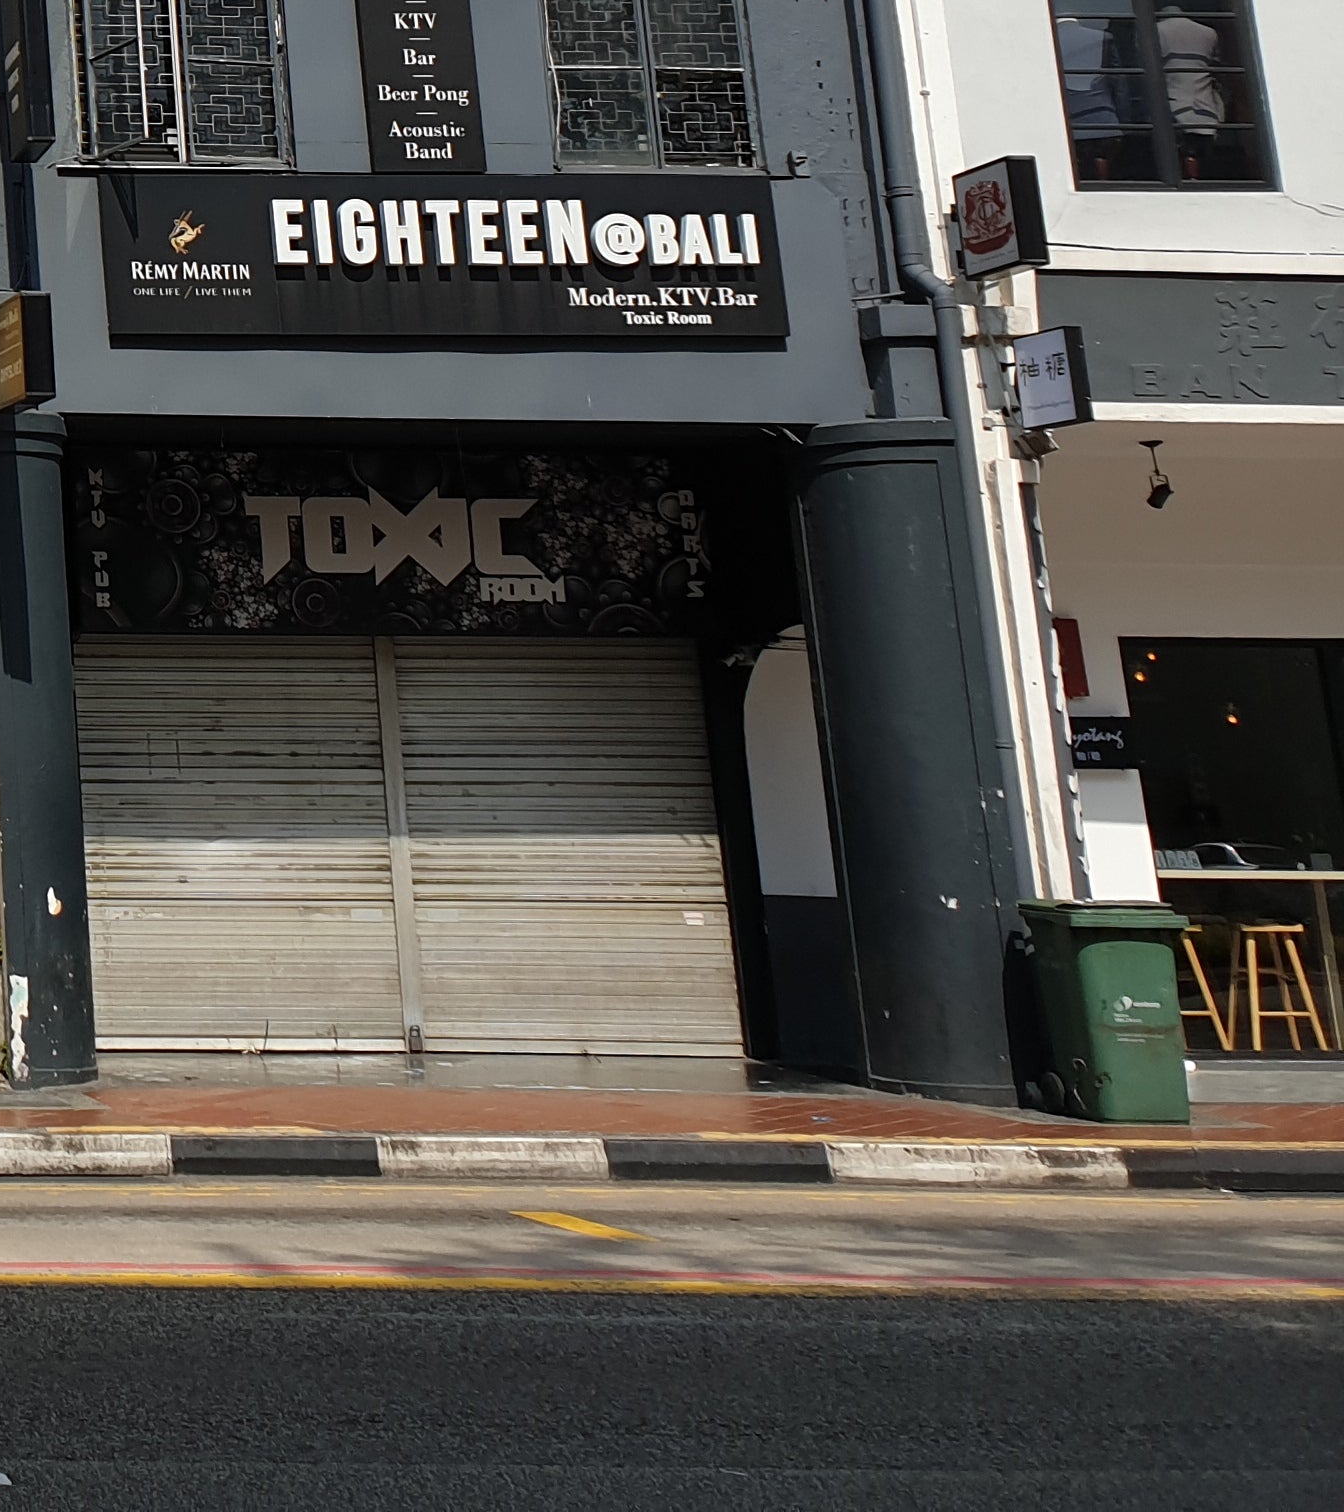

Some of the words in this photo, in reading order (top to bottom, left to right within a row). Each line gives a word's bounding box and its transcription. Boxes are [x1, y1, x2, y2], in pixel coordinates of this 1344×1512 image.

[393, 12, 437, 30] KTV
[402, 48, 436, 66] Bar
[377, 84, 418, 101] Beer
[423, 84, 470, 107] Pong
[388, 120, 466, 138] Acoustic
[404, 142, 453, 159] Band
[270, 198, 762, 267] EIGHTEEN@BALI
[132, 287, 157, 297] ONE
[159, 287, 181, 297] LIFE
[195, 287, 218, 297] LIVE
[222, 287, 252, 297] THEM
[622, 311, 665, 325] Toxic
[666, 311, 713, 325] Room
[242, 485, 546, 588] TOXIC
[479, 575, 567, 605] ROOM
